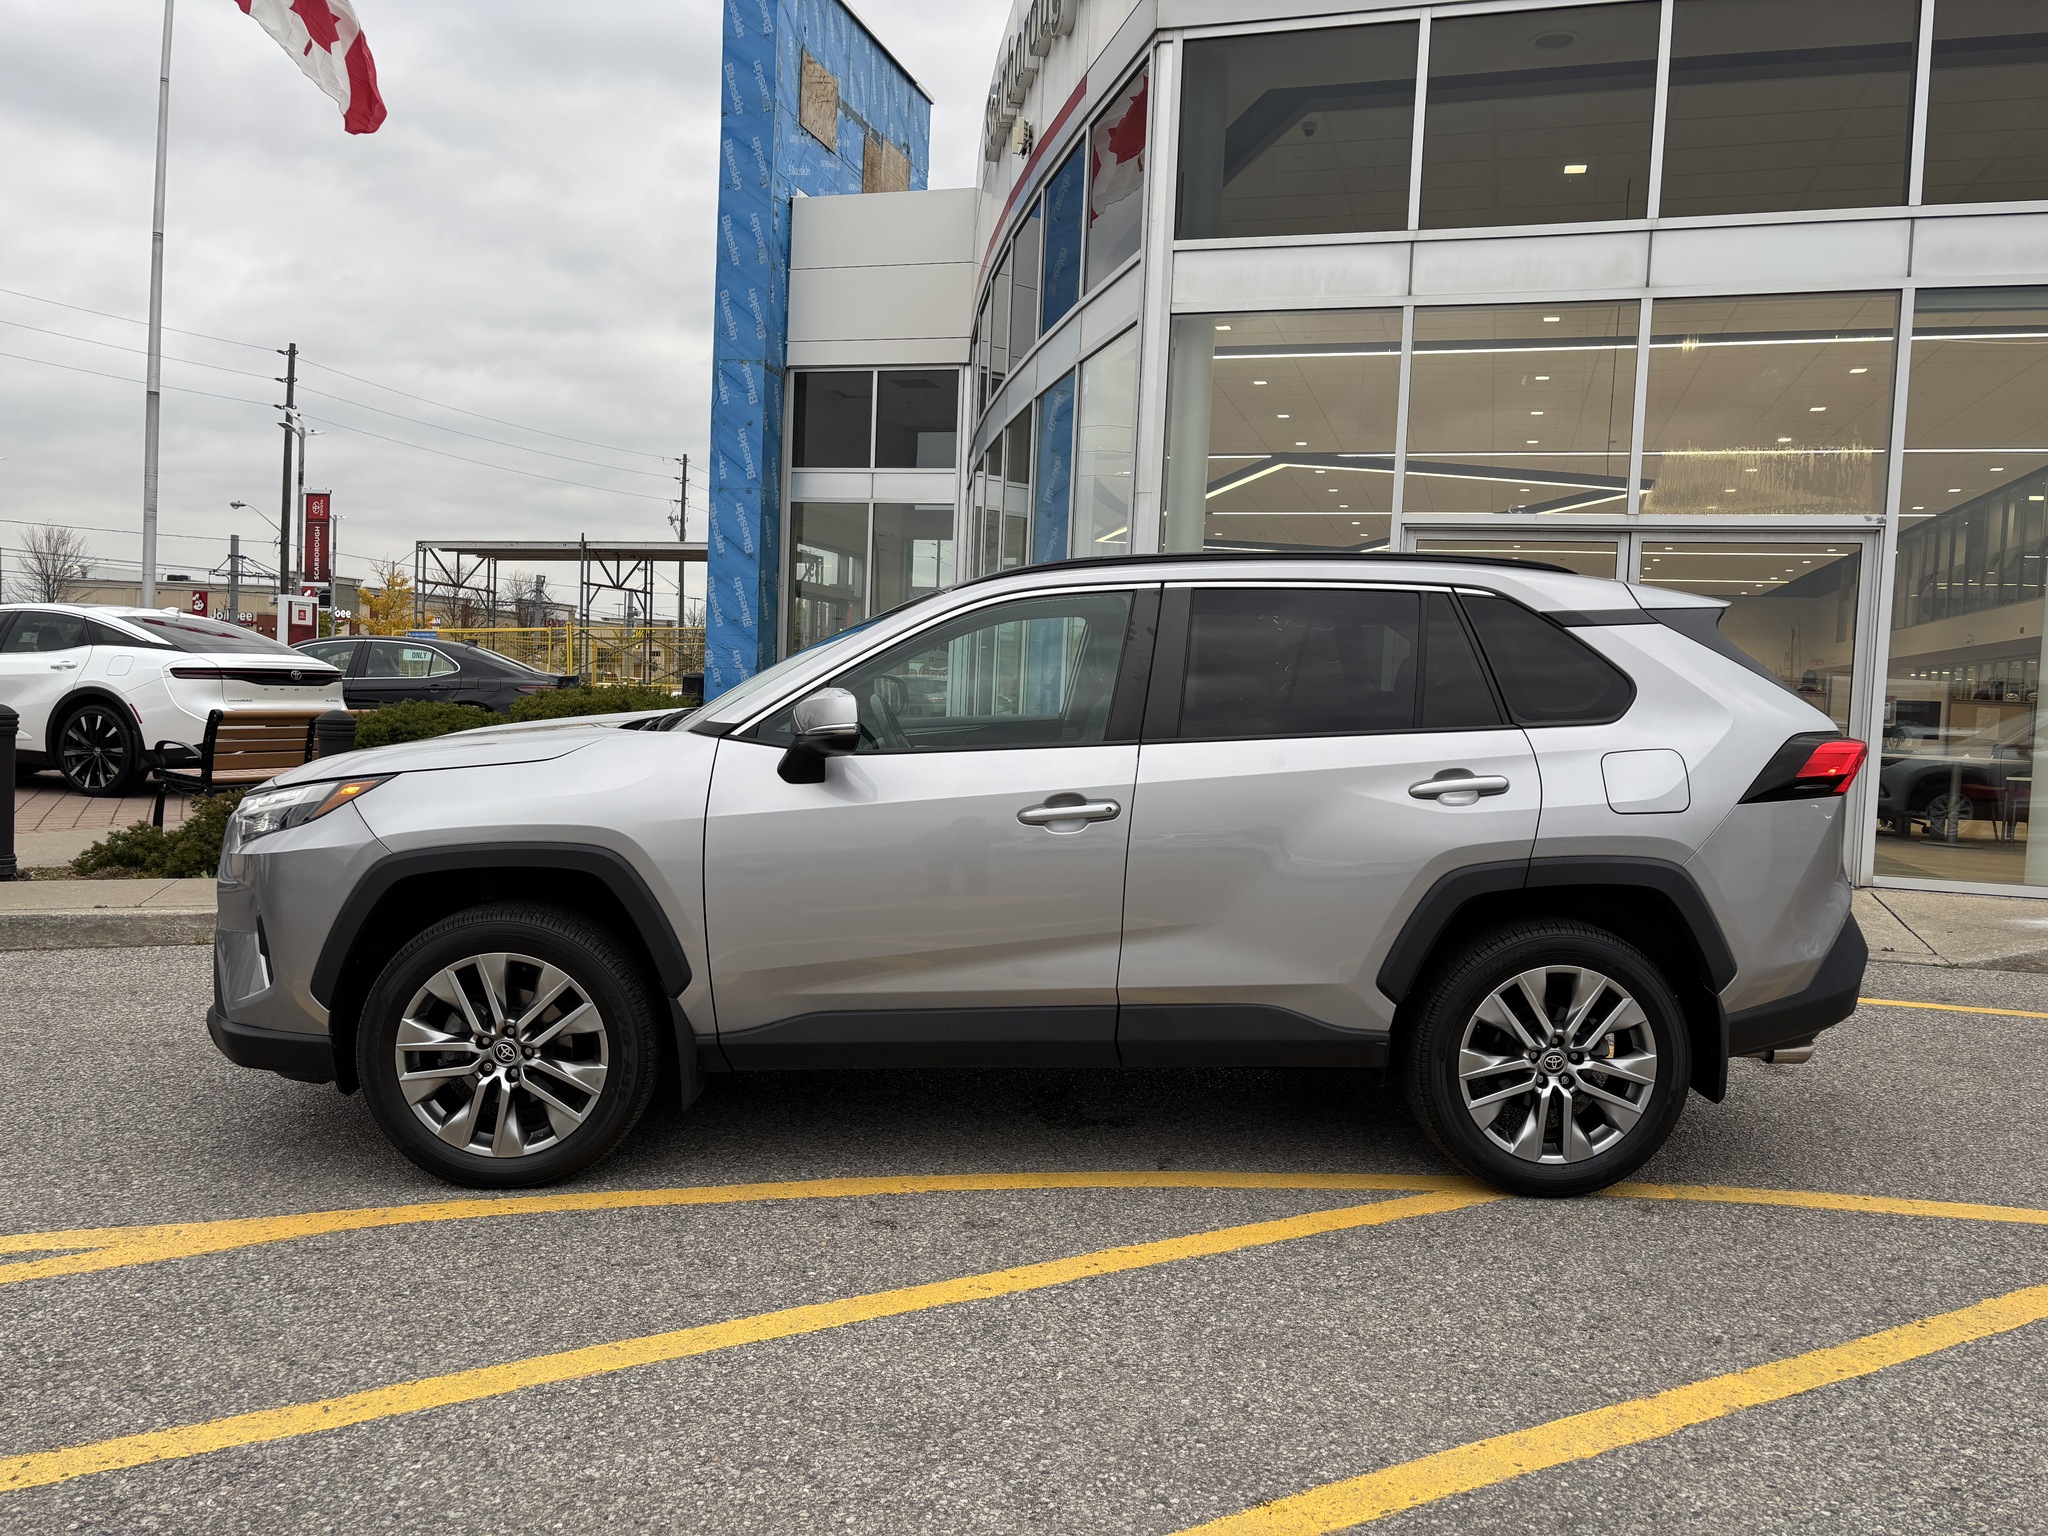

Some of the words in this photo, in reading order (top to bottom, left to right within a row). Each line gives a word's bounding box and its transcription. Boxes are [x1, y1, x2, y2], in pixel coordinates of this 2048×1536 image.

[728, 0, 745, 38] ueskin
[757, 0, 774, 33] Blues
[724, 62, 744, 115] Blueskin
[722, 138, 742, 191] Blueskin
[721, 214, 740, 267] Blueskin
[719, 289, 738, 341] Blueskin
[748, 287, 766, 340] Blueskin
[742, 360, 758, 405] Bluesk
[738, 427, 756, 480] Blueskin
[709, 502, 726, 554] Blueskin
[736, 502, 754, 554] Blueskin
[210, 608, 254, 620] Jollee
[734, 576, 753, 628] Blueskin
[411, 651, 428, 660] ONLY
